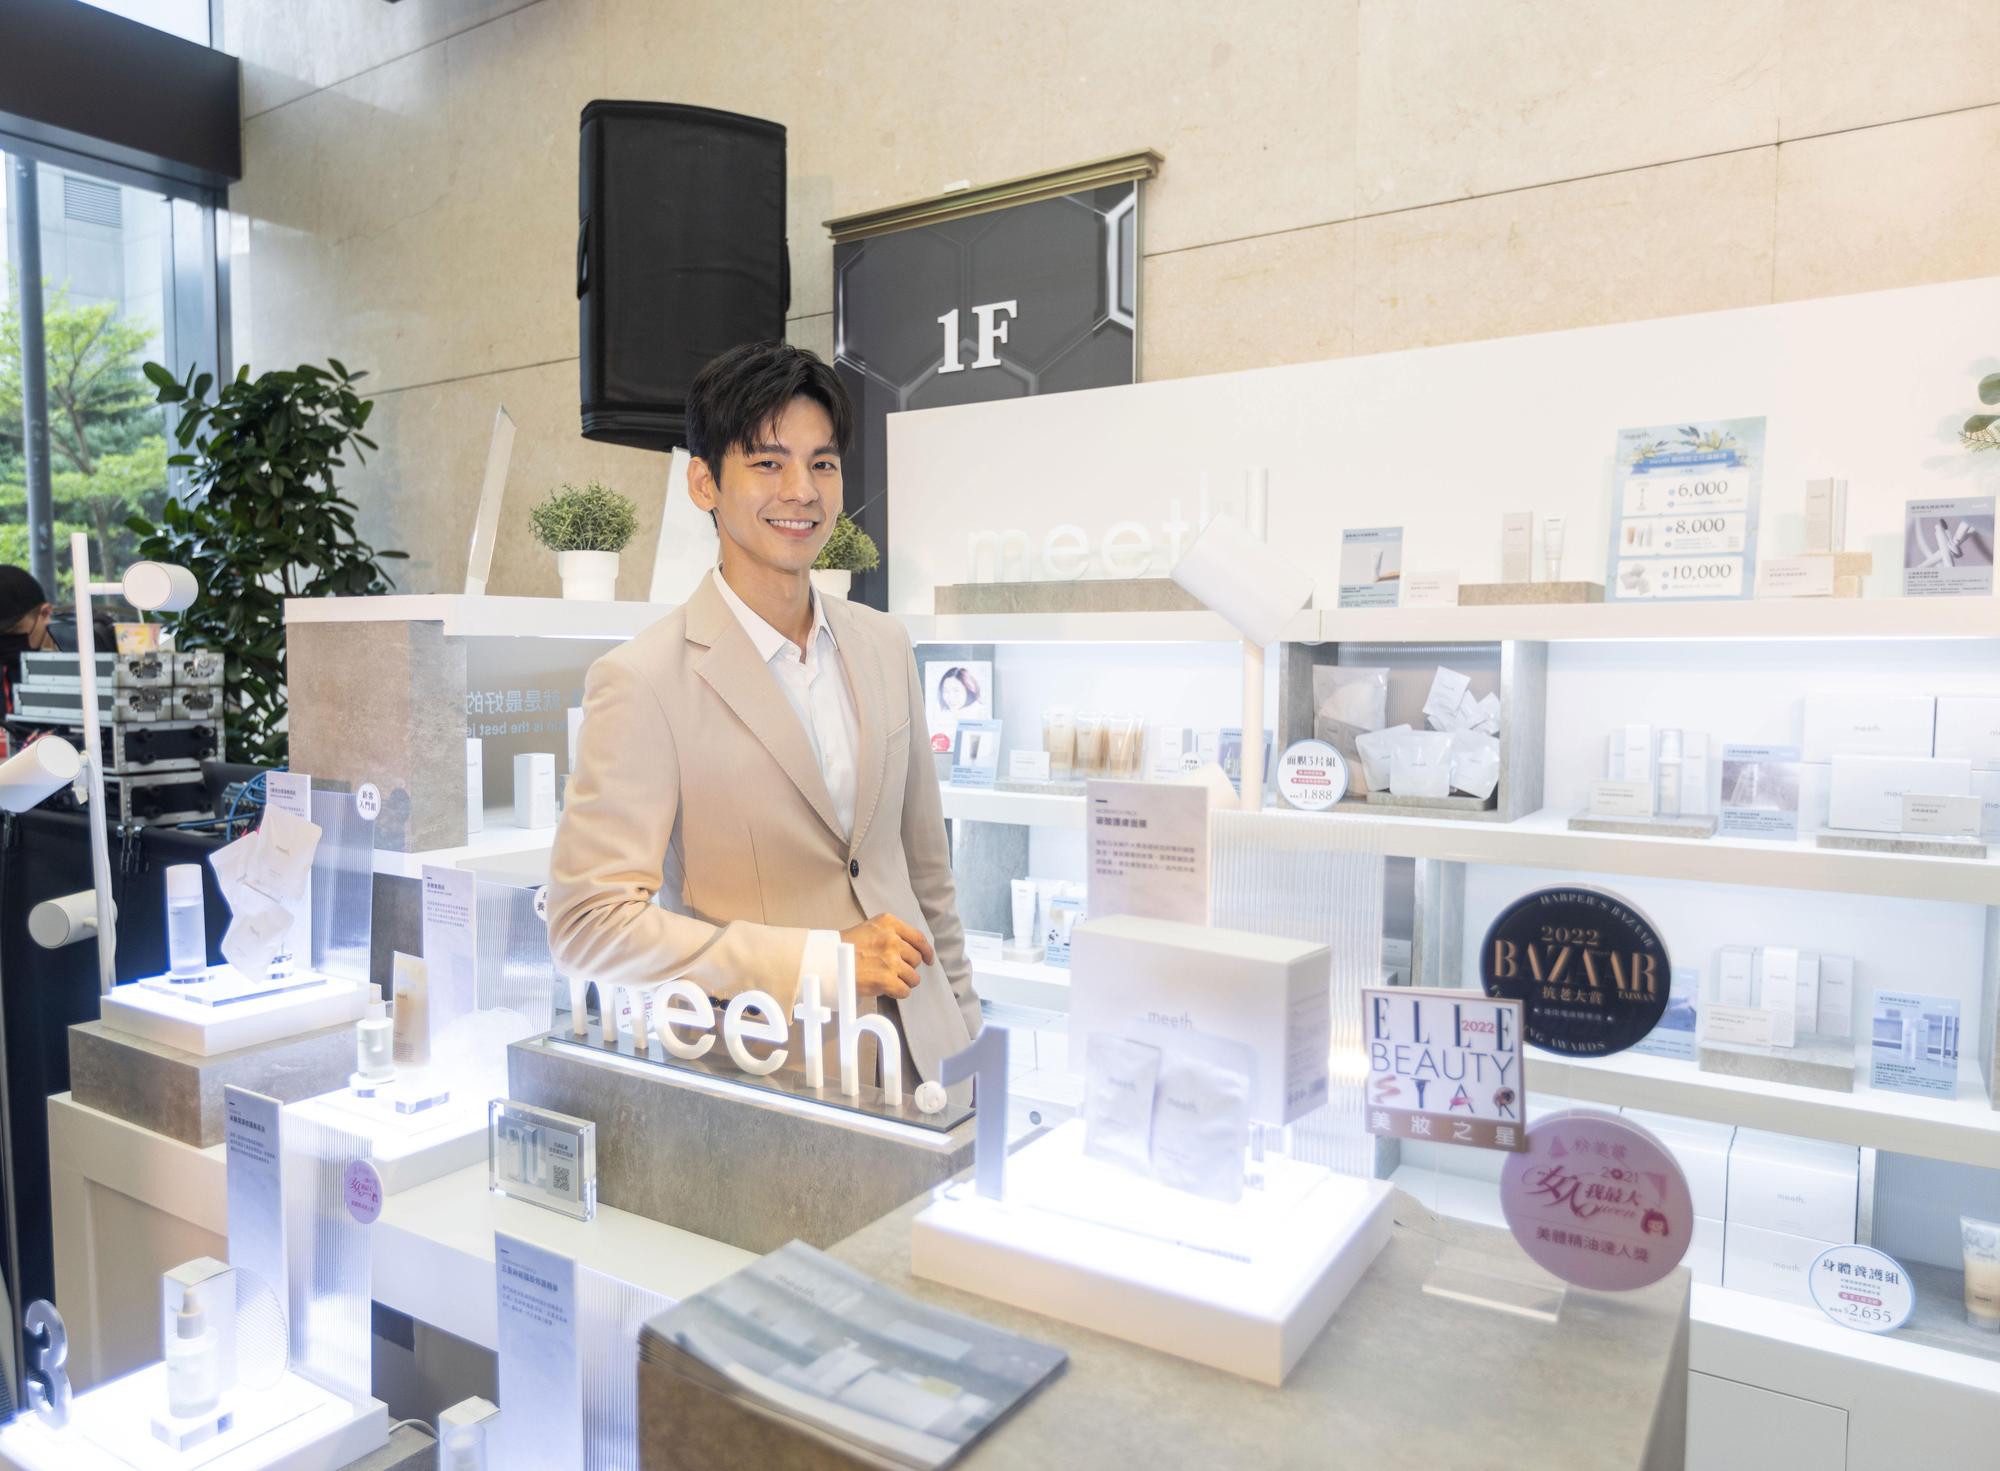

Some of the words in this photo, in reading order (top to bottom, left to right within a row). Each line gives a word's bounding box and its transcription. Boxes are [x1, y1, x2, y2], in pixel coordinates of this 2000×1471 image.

[937, 300, 1017, 374] 1F
[1678, 480, 1729, 498] 6,000
[1675, 517, 1726, 535] 8,000
[1672, 563, 1732, 581] 10,000
[1540, 925, 1599, 945] 2022
[1494, 939, 1658, 995] BAZAAR
[1373, 997, 1514, 1053] ELLE
[1461, 1019, 1495, 1035] 2022
[1371, 1042, 1514, 1085] BEAUTY
[1374, 1074, 1516, 1119] STAR
[1371, 1111, 1516, 1146] 美妝之星
[1600, 1166, 1639, 1183] 2021
[1823, 1258, 1900, 1285] 身體養護組
[24, 1299, 72, 1429] 3
